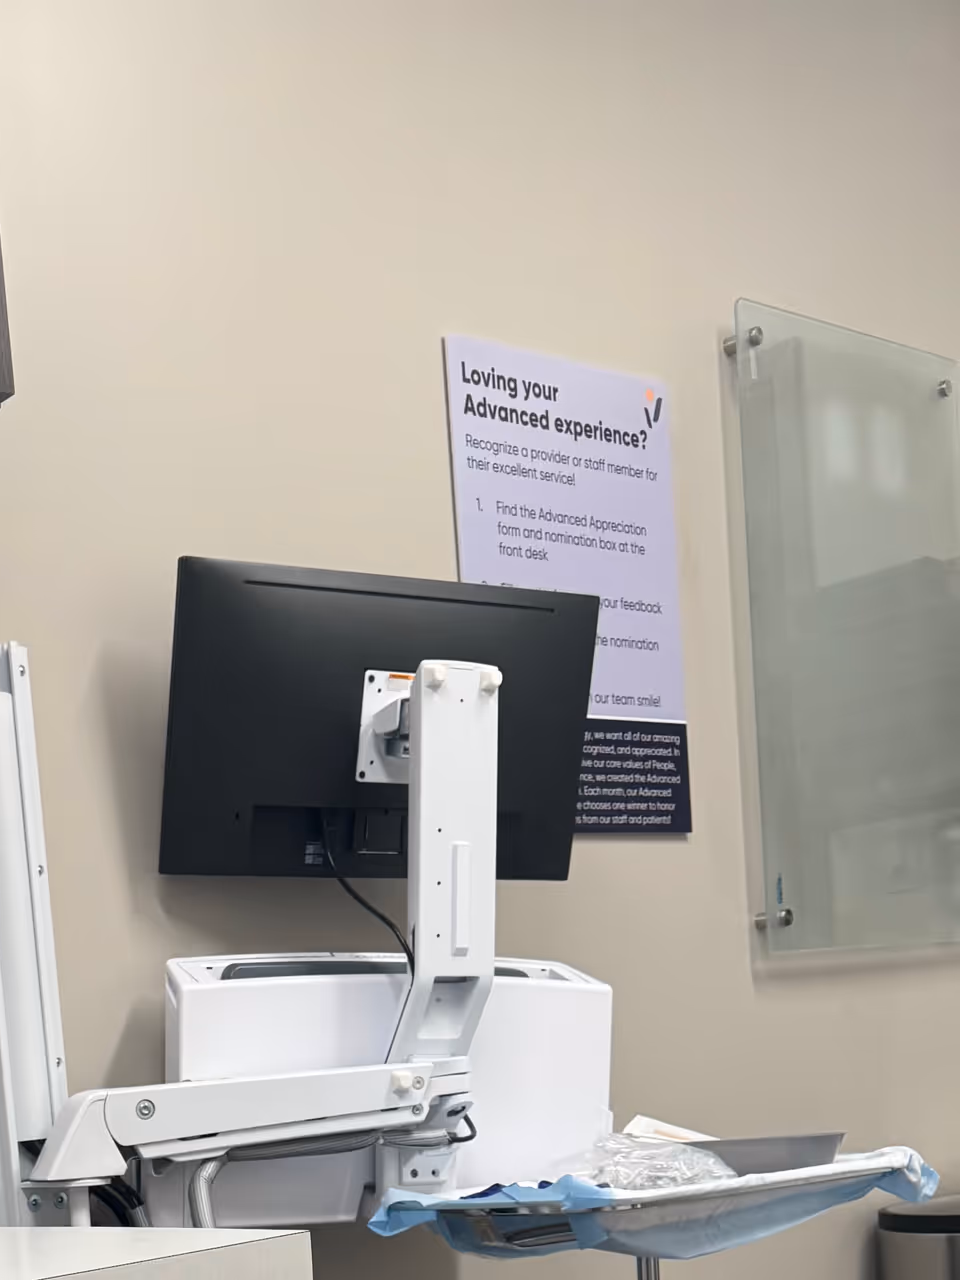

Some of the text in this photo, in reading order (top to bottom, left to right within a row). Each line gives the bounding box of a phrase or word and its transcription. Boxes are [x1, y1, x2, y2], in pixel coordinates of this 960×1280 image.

[461, 361, 558, 402] Loving your
[464, 394, 647, 449] Advanced experience?
[465, 433, 658, 482] Recognize a provider or staff member for
[467, 455, 576, 486] their excellent service!
[476, 497, 483, 512] 1.
[496, 500, 647, 537] Find the Advanced Appreciation
[498, 521, 646, 555] form and nomination box at the
[498, 542, 523, 558] front
[620, 597, 662, 615] feedback
[596, 633, 659, 652] he nomination
[594, 693, 609, 704] our
[612, 693, 636, 706] team
[637, 694, 661, 708] smile!
[594, 732, 604, 740] we
[606, 732, 622, 740] want
[653, 734, 680, 745] amazing
[583, 744, 616, 755] cognized,
[617, 746, 631, 754] and
[623, 760, 643, 769] values
[580, 774, 595, 782] nce,
[607, 774, 633, 782] created
[635, 774, 646, 782] the
[647, 774, 680, 783] Advanced
[584, 786, 601, 795] Each
[639, 787, 672, 797] Advanced
[583, 801, 611, 810] chooses
[612, 802, 625, 810] one
[657, 802, 676, 811] honor
[583, 814, 599, 824] from
[600, 816, 611, 824] our
[612, 815, 627, 824] staff
[628, 816, 642, 824] and
